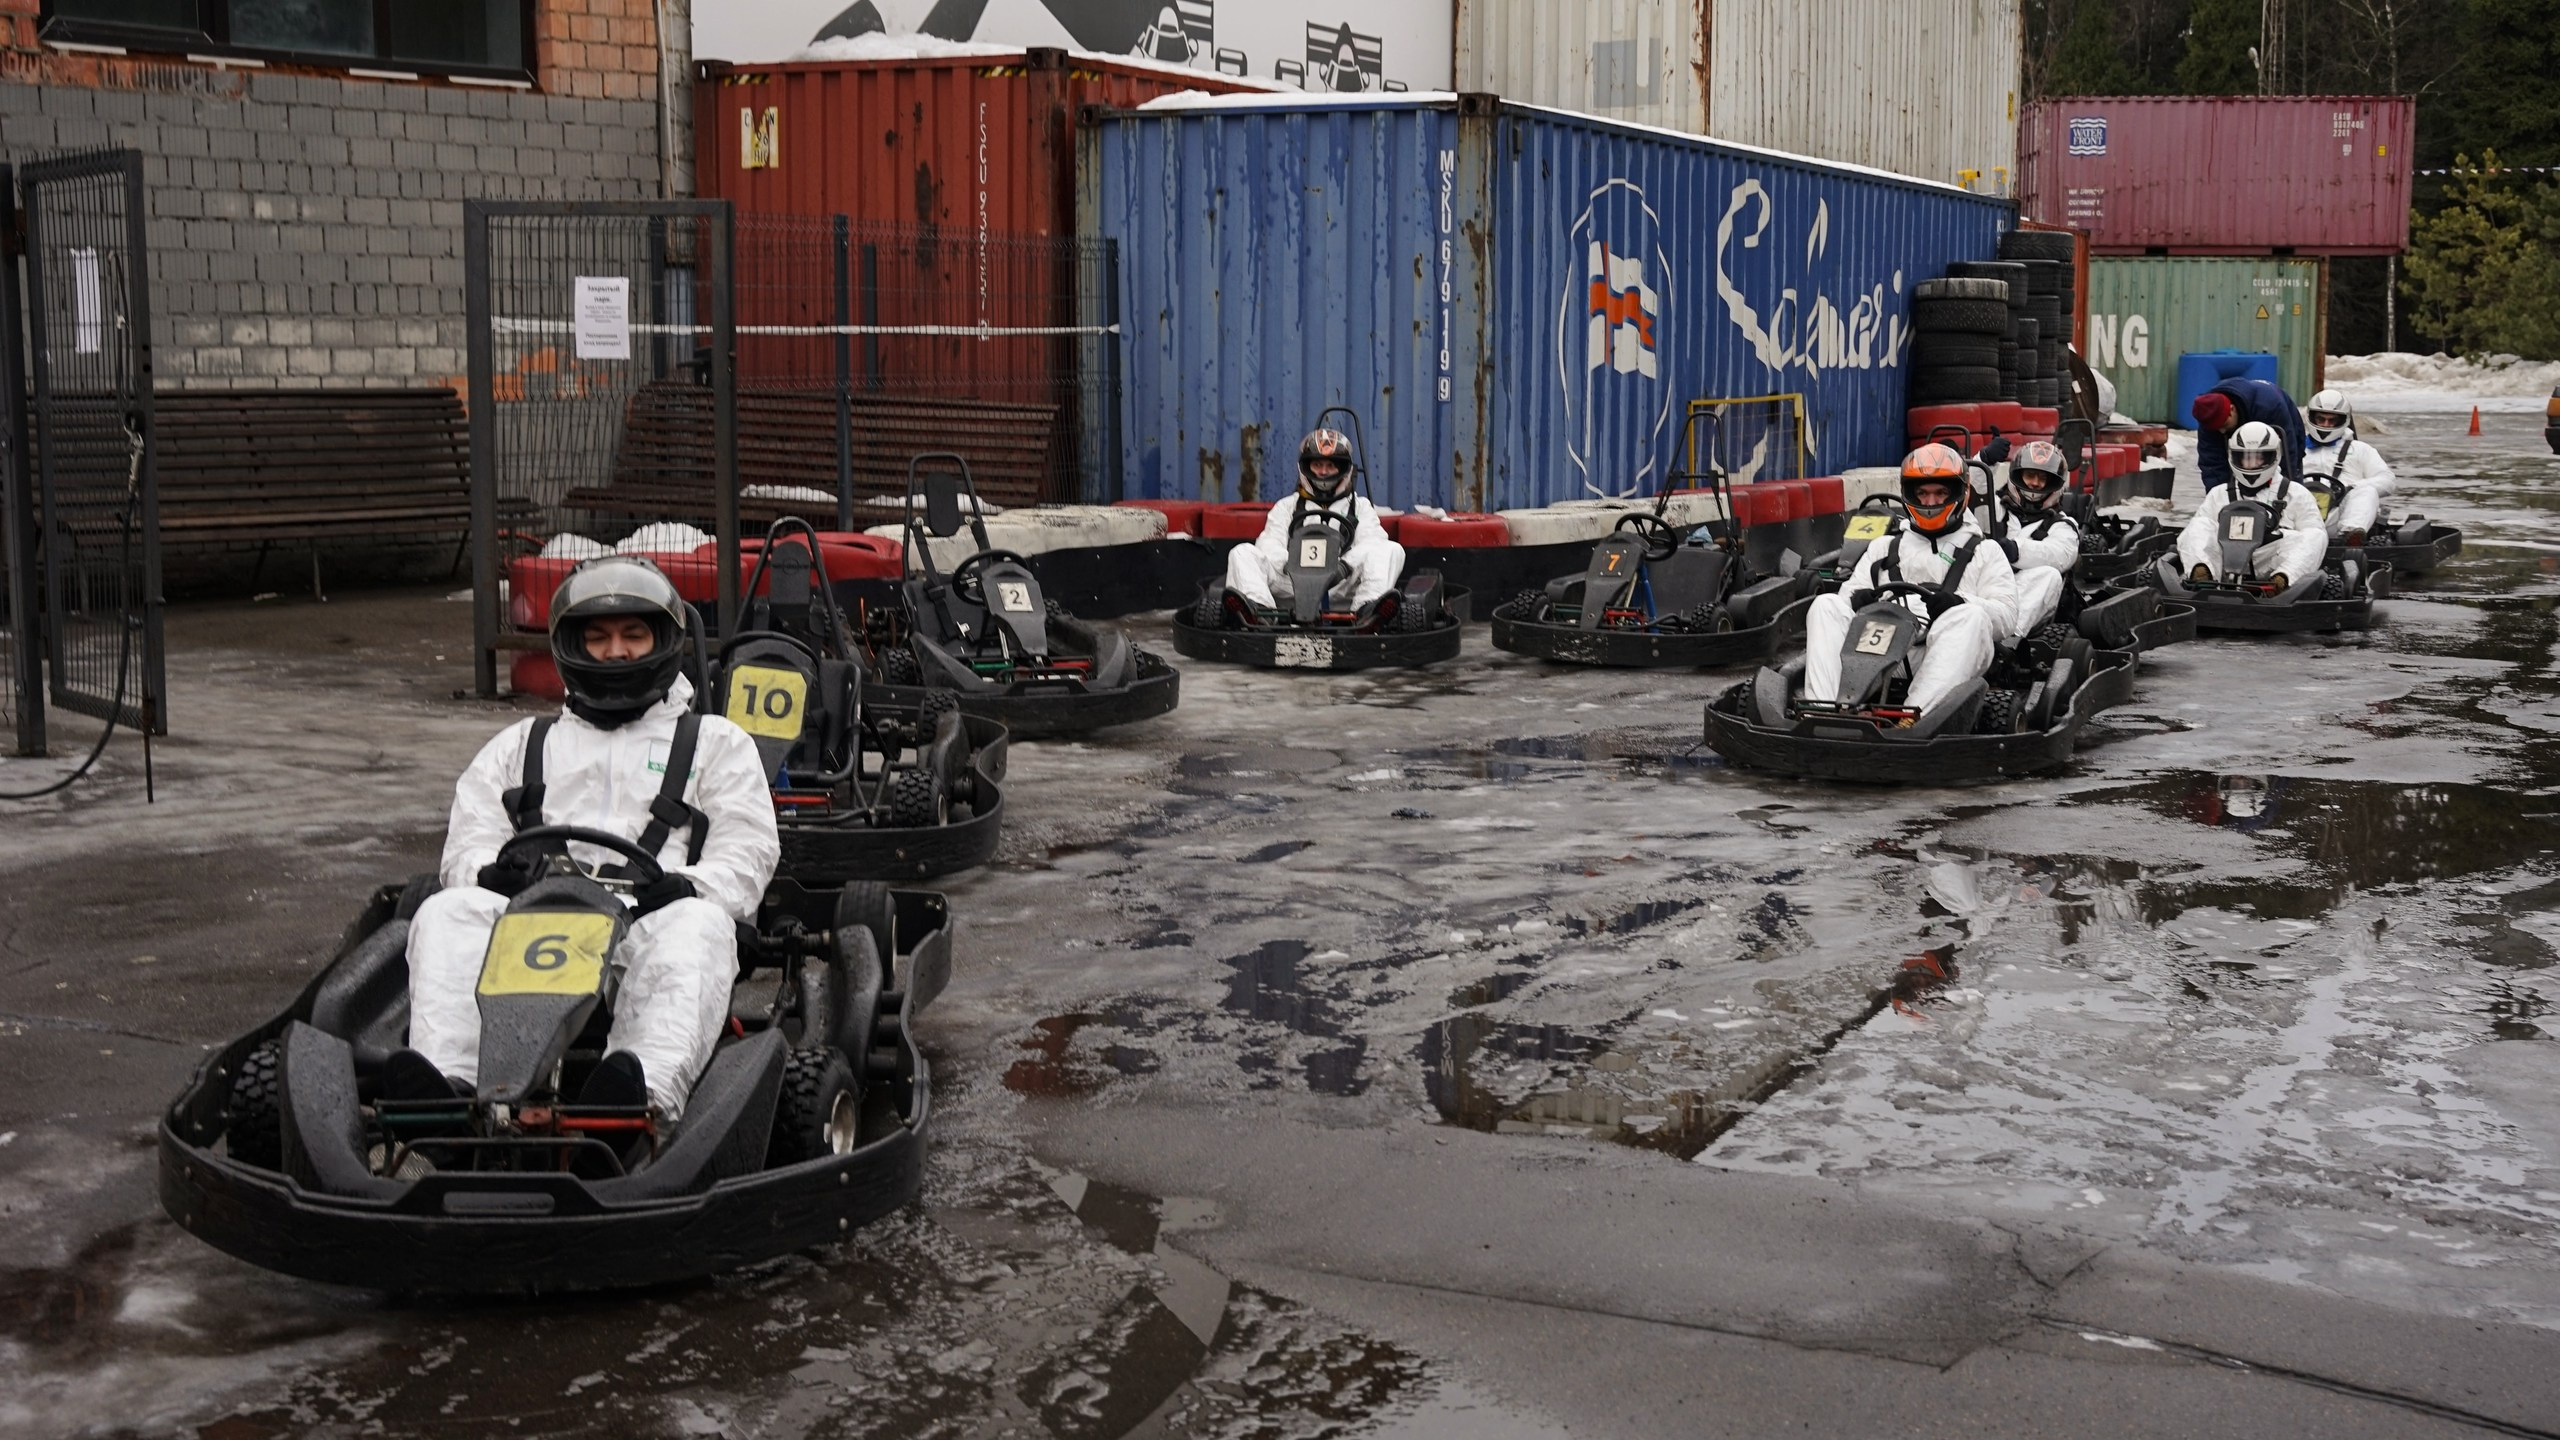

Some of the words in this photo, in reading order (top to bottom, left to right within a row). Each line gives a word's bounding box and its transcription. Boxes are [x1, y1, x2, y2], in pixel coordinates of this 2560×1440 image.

[2073, 128, 2103, 137] WATER
[2074, 137, 2103, 146] FRONT
[1440, 149, 1455, 234] MSKU
[2089, 314, 2148, 368] NG
[1440, 378, 1449, 400] 9
[1857, 522, 1874, 534] 4
[2238, 521, 2245, 535] 1
[1309, 545, 1318, 561] 3
[1608, 553, 1621, 571] 7
[1009, 590, 1023, 605] 2
[1869, 629, 1884, 646] 5
[742, 683, 793, 720] 10
[524, 934, 570, 970] 6
